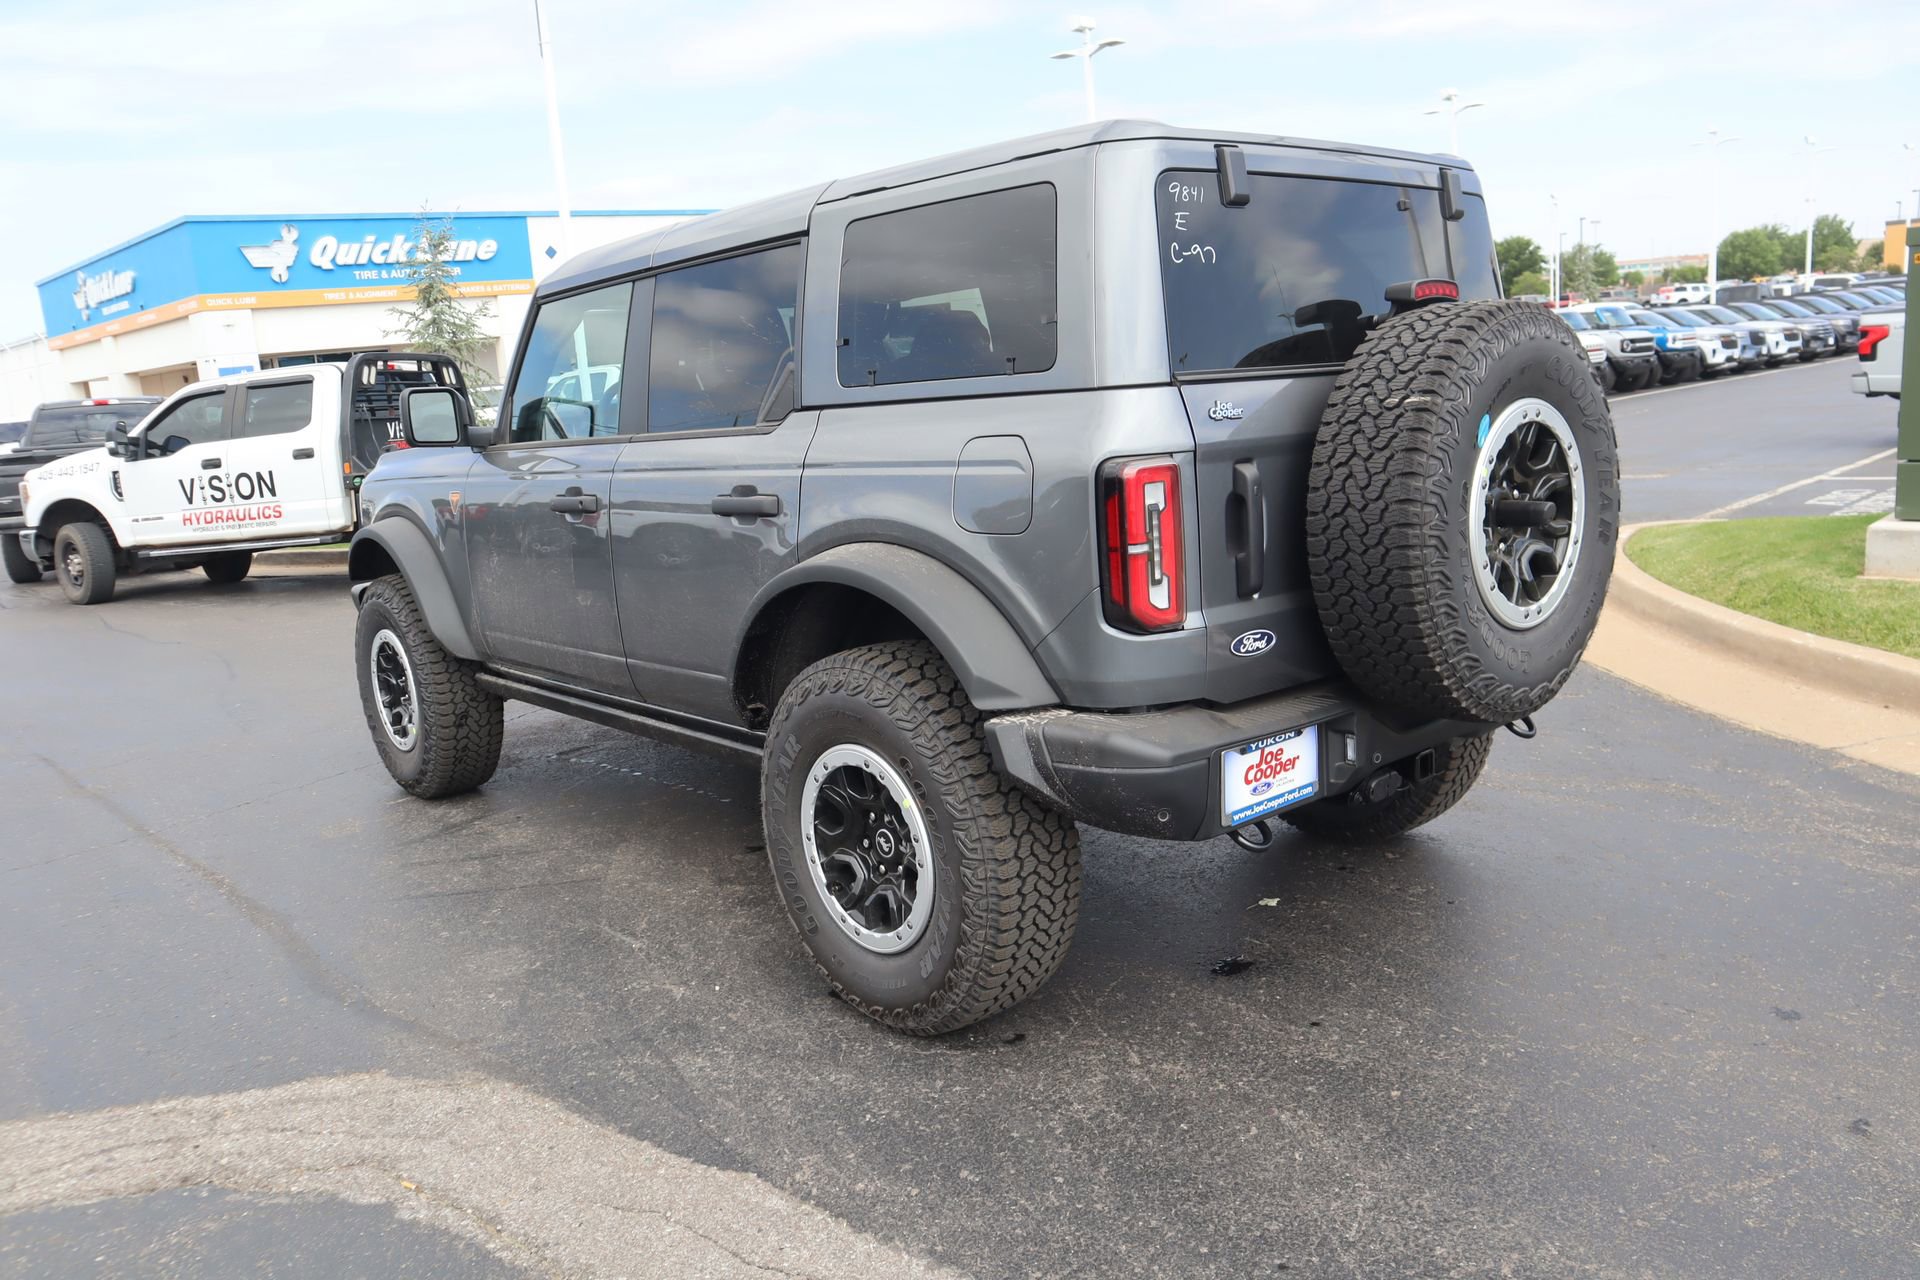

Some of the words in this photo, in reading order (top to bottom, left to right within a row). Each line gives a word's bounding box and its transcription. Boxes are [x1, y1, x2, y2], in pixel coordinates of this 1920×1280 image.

[1168, 181, 1204, 203] 9841
[1174, 211, 1190, 231] E
[309, 234, 415, 270] Quick
[353, 269, 379, 280] TIRE
[381, 269, 389, 279] &
[206, 297, 234, 307] QUICK
[235, 296, 257, 306] LUBE
[323, 292, 346, 301] TIRES
[355, 289, 398, 299] ALIGNMENT
[1208, 407, 1244, 419] Cooper
[1214, 400, 1233, 411] Joe
[1545, 355, 1615, 546] GOODYEAR
[178, 470, 277, 505] VISION
[182, 504, 283, 526] HYDRAULICS
[1240, 633, 1268, 653] Ford
[1249, 731, 1295, 751] YUKON
[1255, 747, 1284, 769] Joe
[1244, 755, 1300, 786] Cooper
[767, 733, 820, 937] GOODYEAR
